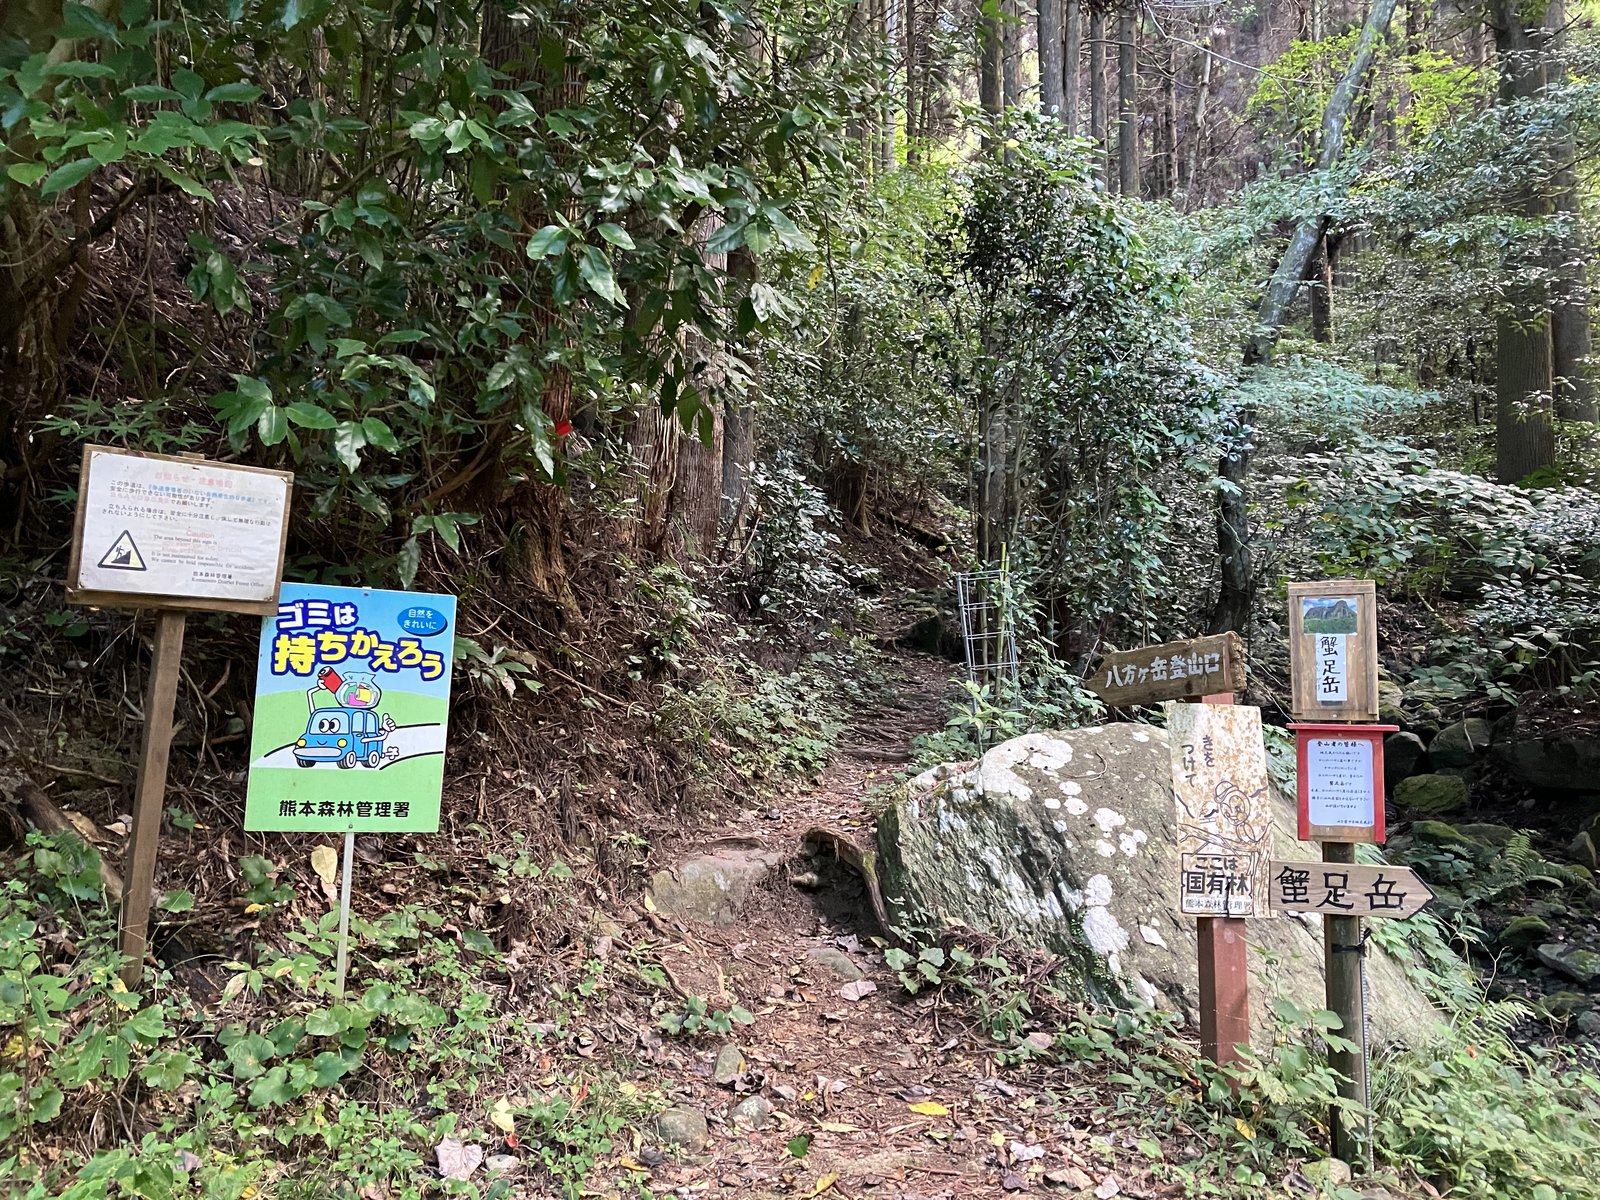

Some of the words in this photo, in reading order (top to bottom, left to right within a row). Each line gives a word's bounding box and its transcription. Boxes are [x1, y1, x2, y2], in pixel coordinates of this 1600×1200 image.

[276, 600, 358, 630] ゴミは
[402, 619, 438, 631] きれいに
[407, 608, 434, 619] 自然を
[272, 629, 444, 680] 持ちかえろう
[1319, 635, 1341, 694] 蟹足岳
[1104, 651, 1221, 689] 八方ヶ岳登山口
[1202, 734, 1215, 768] きを
[1317, 740, 1365, 748] 登山者の皆様へ
[1181, 742, 1197, 788] つけて
[278, 799, 410, 818] 熊本森林管理署
[1194, 856, 1238, 871] ここは
[1186, 871, 1250, 896] 国有林
[1274, 865, 1407, 911] 蟹足岳
